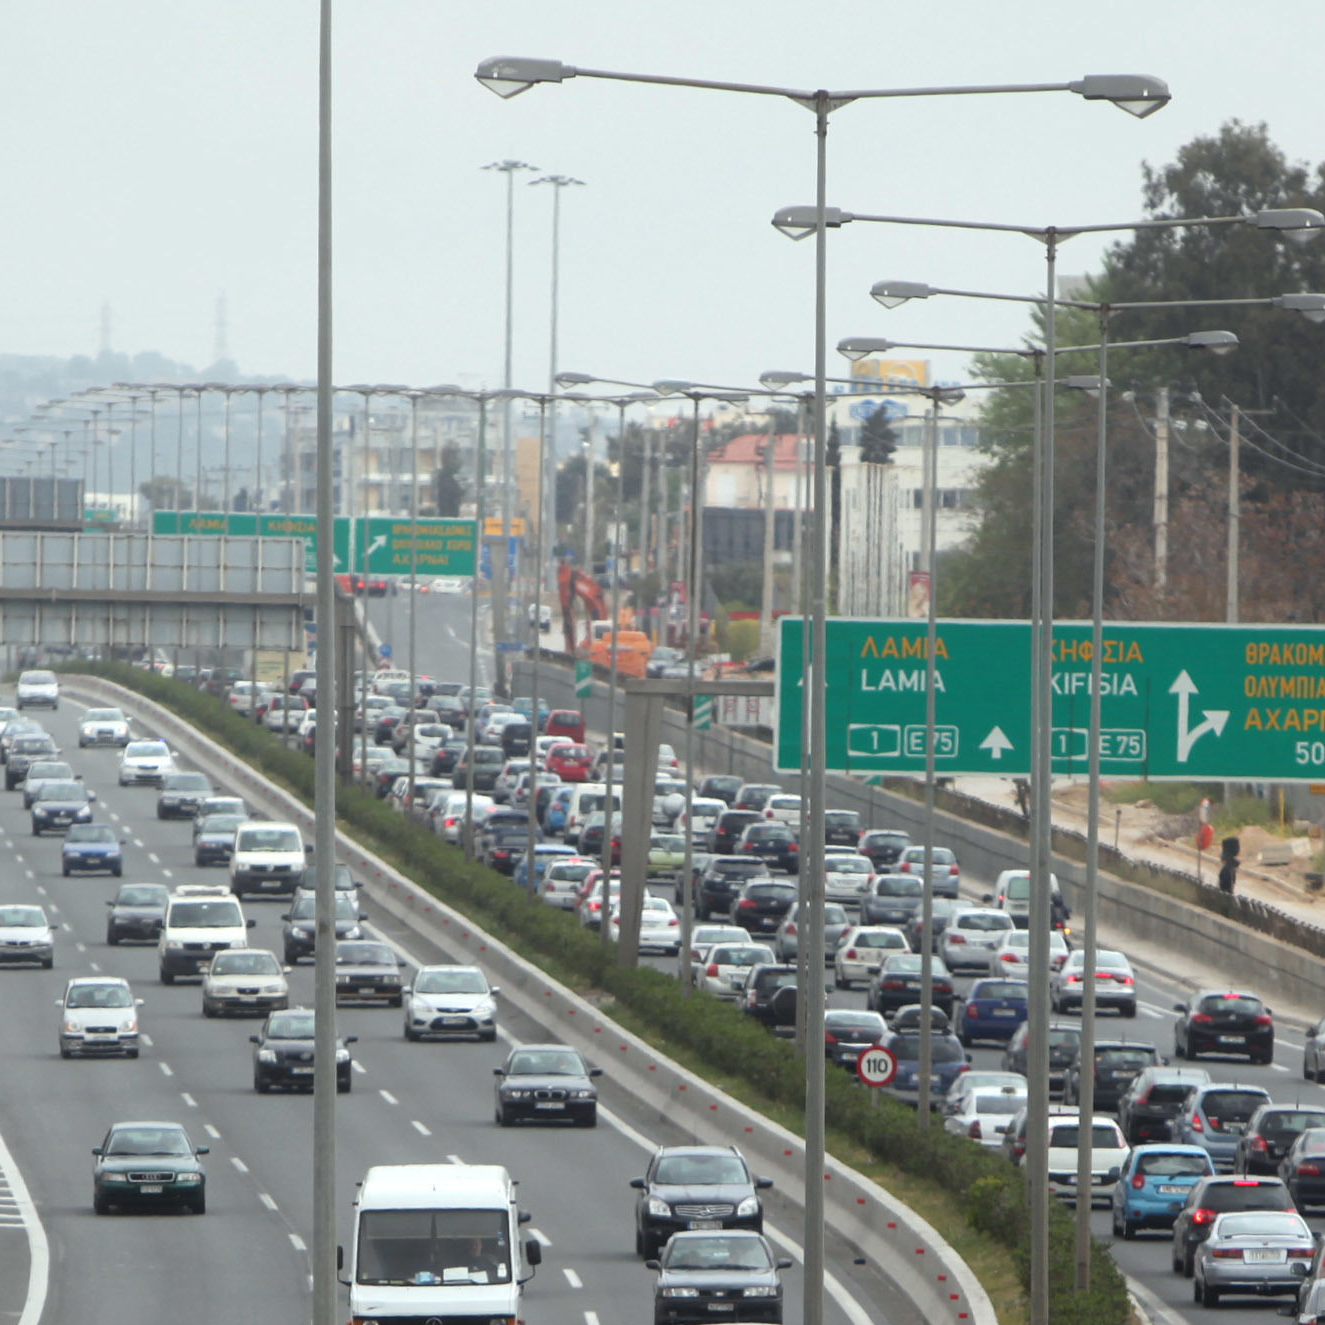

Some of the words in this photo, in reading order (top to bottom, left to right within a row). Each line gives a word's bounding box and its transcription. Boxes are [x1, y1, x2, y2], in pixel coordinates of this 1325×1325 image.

[861, 636, 950, 660] ΛΑΜΙΑ
[1050, 639, 1144, 663] ΗΦΣΙΑ
[861, 669, 946, 693] LAMIA
[871, 731, 879, 750] 1
[1116, 736, 1141, 755] 75
[867, 1058, 888, 1074] 110
